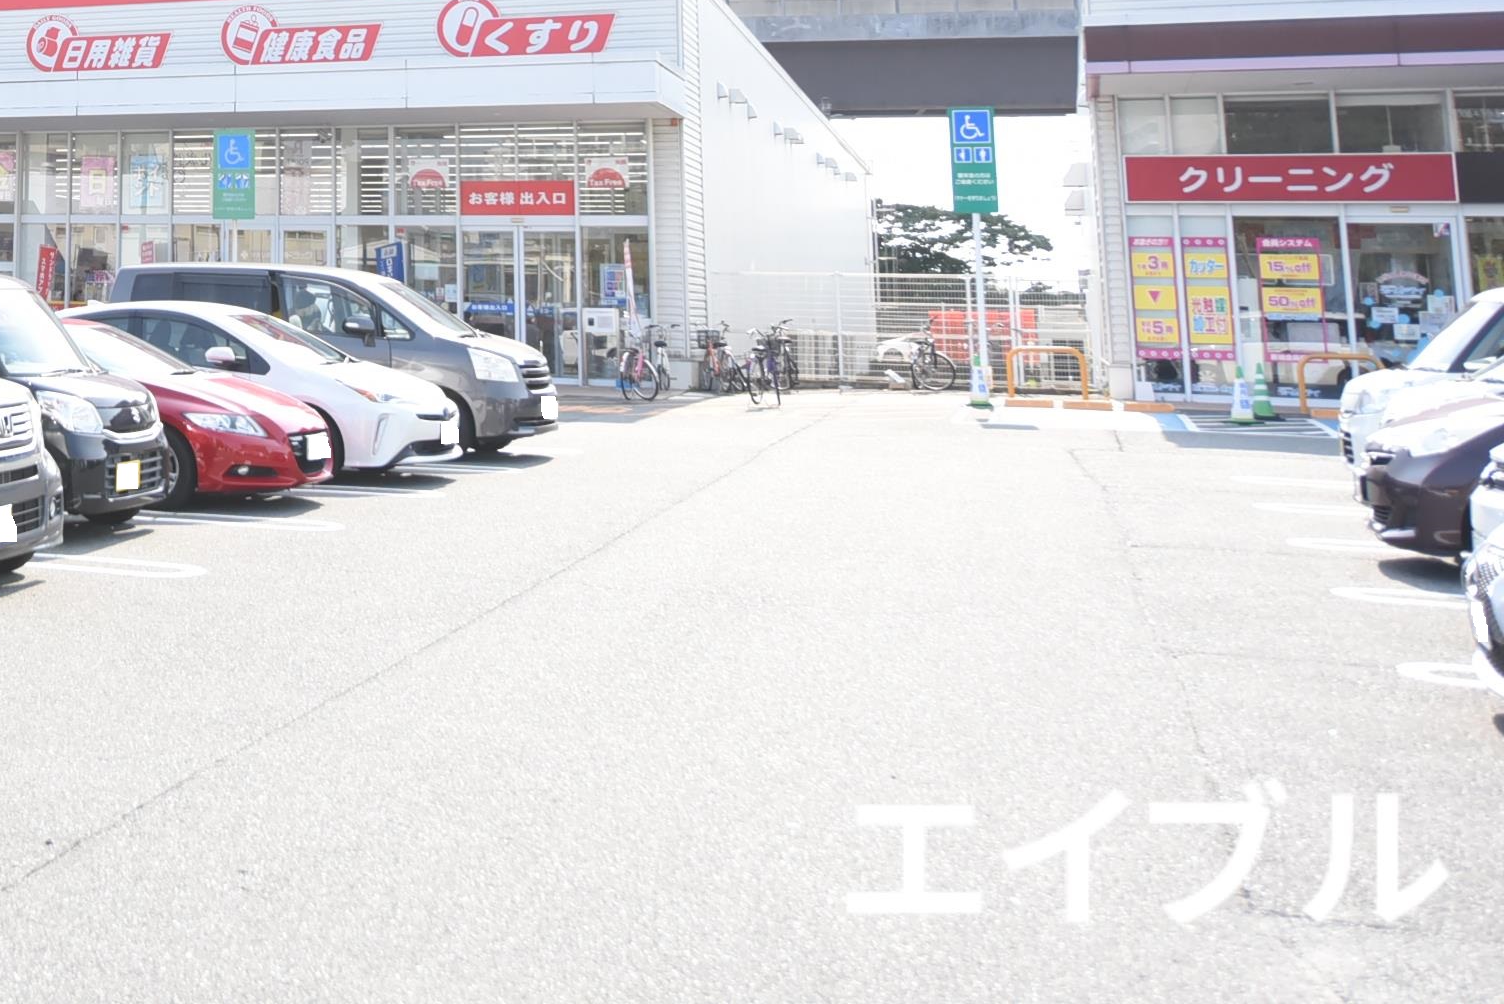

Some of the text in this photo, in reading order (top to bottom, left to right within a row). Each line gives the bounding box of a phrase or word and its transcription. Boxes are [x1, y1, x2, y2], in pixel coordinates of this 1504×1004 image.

[62, 36, 161, 68] 日用雑貨
[259, 28, 368, 63] 健康食品
[484, 19, 599, 54] くすり
[89, 169, 107, 195] 日
[1179, 162, 1394, 194] クリーニング
[468, 191, 566, 205] お客様 出入口
